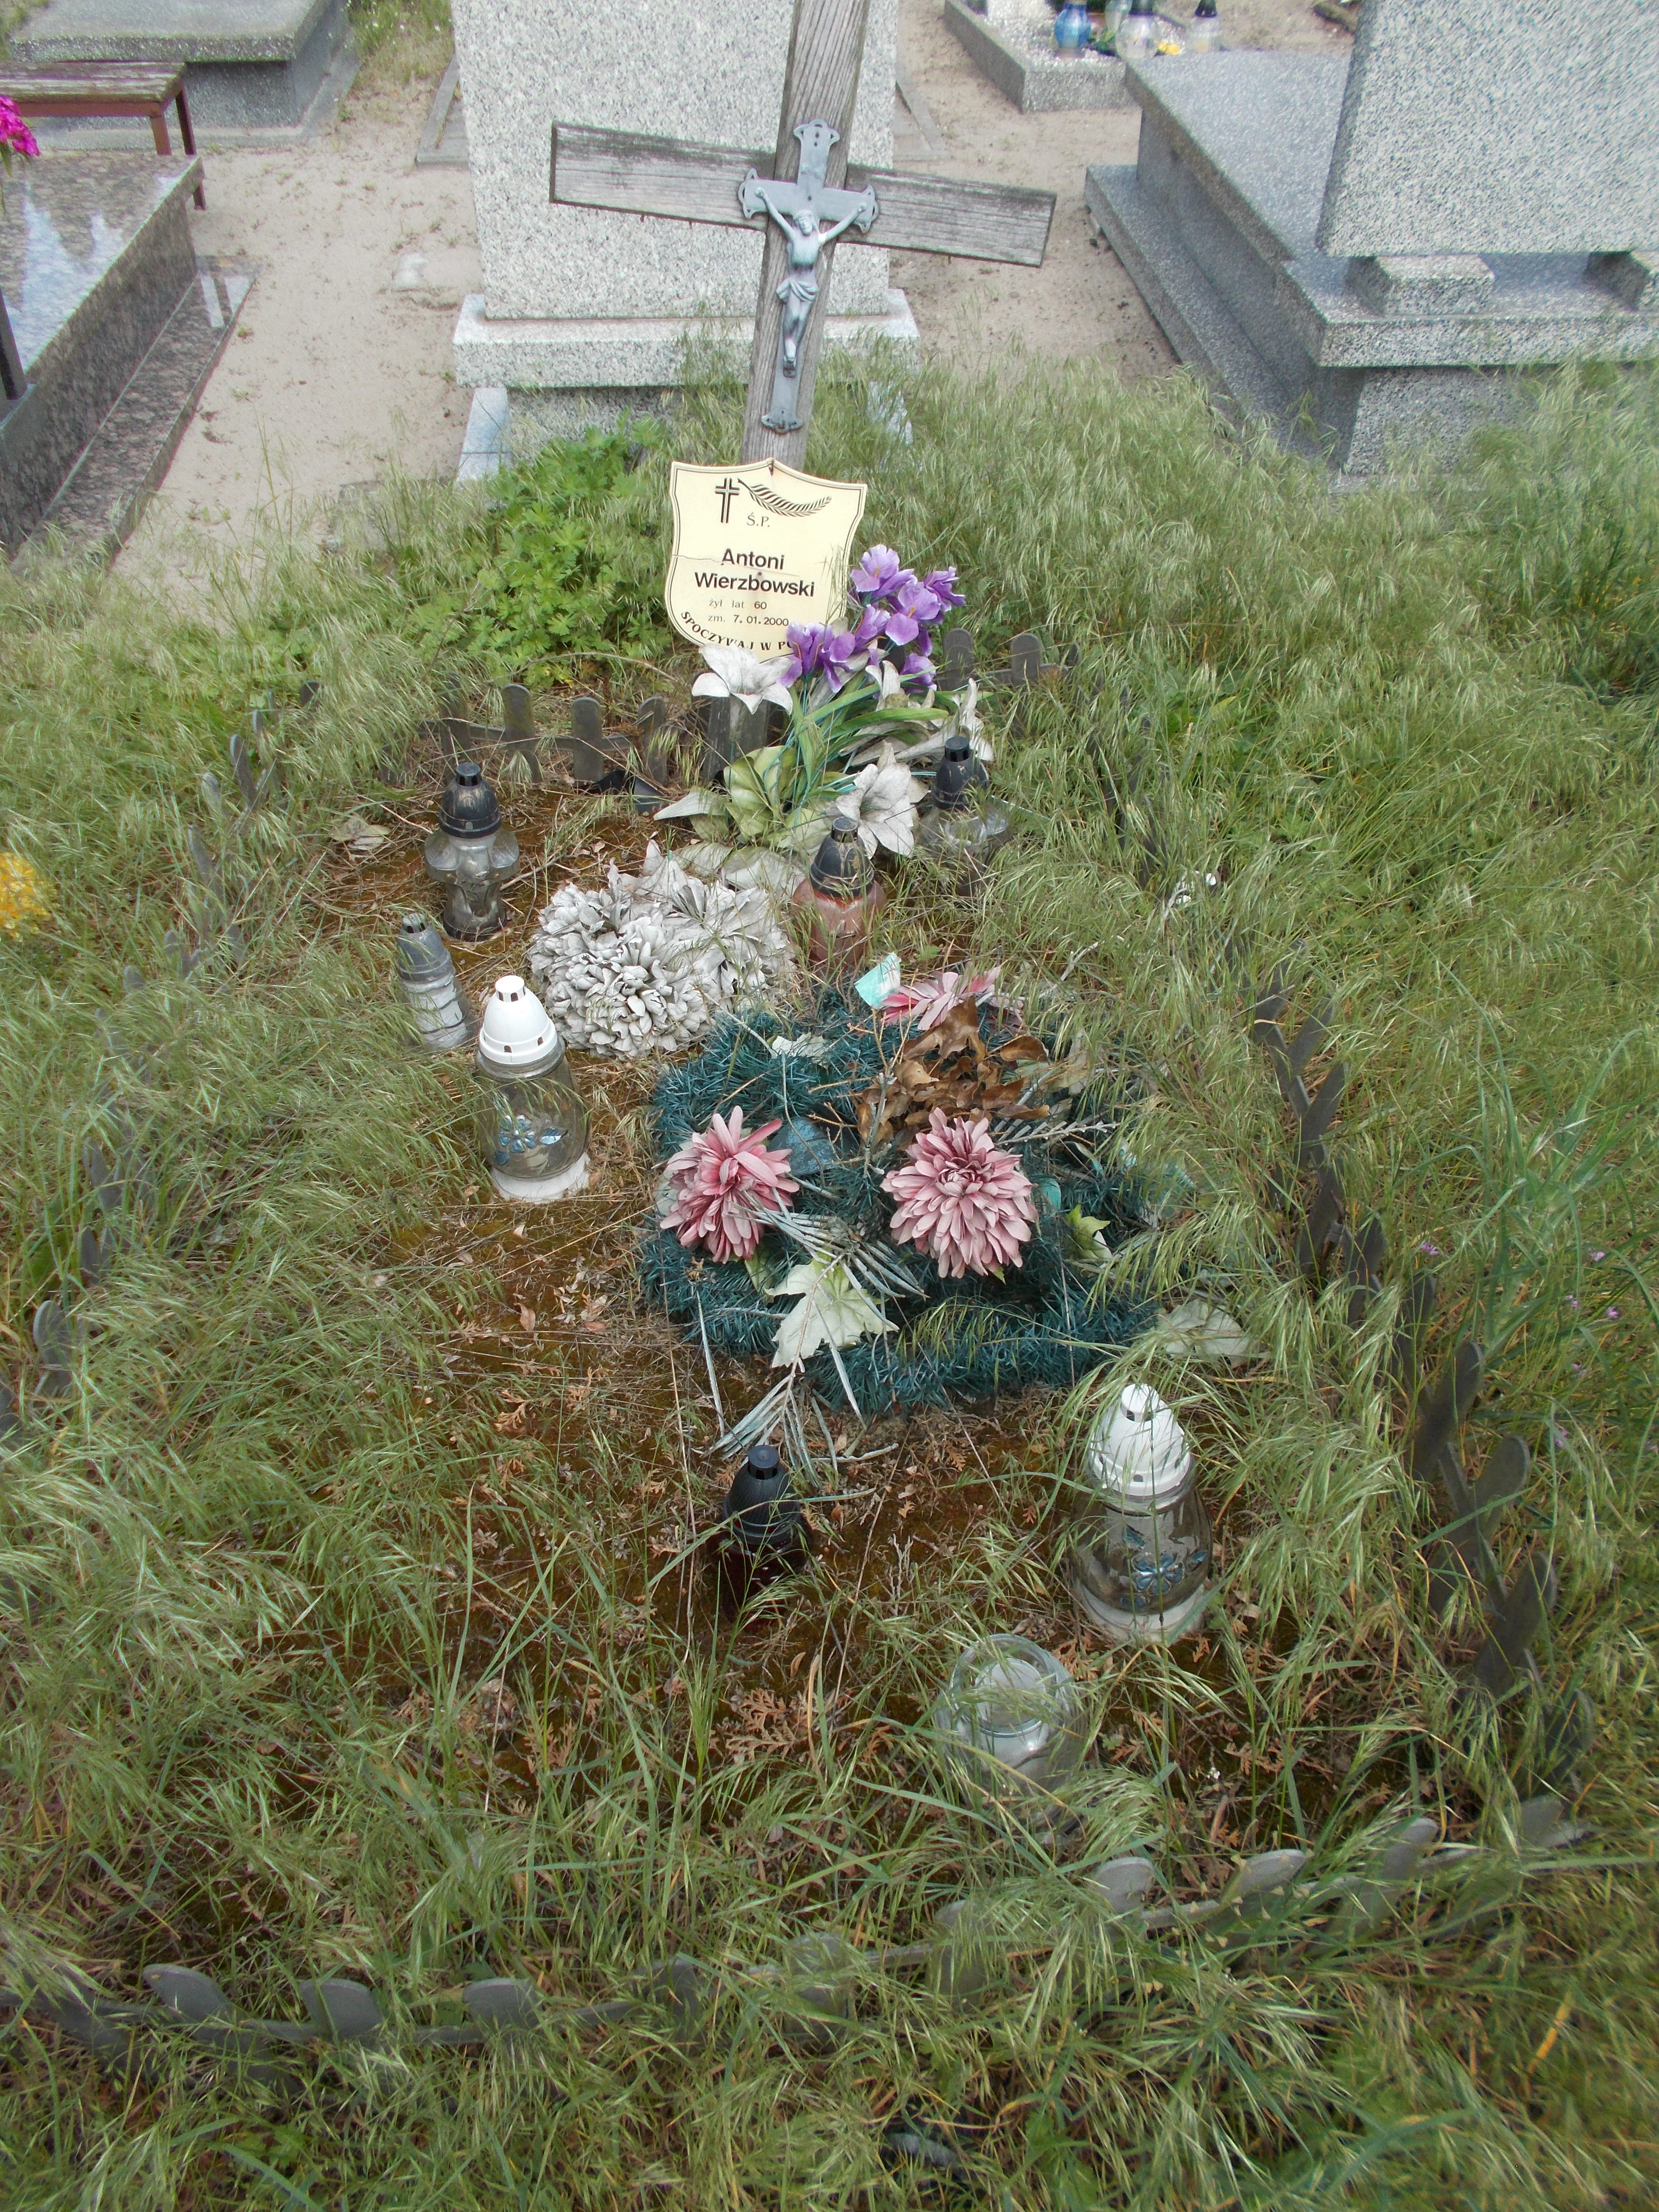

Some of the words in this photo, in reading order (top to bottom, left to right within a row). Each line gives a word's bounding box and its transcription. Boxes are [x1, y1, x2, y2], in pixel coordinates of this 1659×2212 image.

[746, 512, 770, 528] Ś.P.
[721, 548, 785, 570] Antoni
[695, 572, 815, 597] Wierzbowski
[709, 599, 722, 608] żył
[732, 600, 745, 609] lat
[754, 601, 767, 610] 60
[681, 611, 754, 650] SPOCZYWAJ
[761, 642, 772, 651] W
